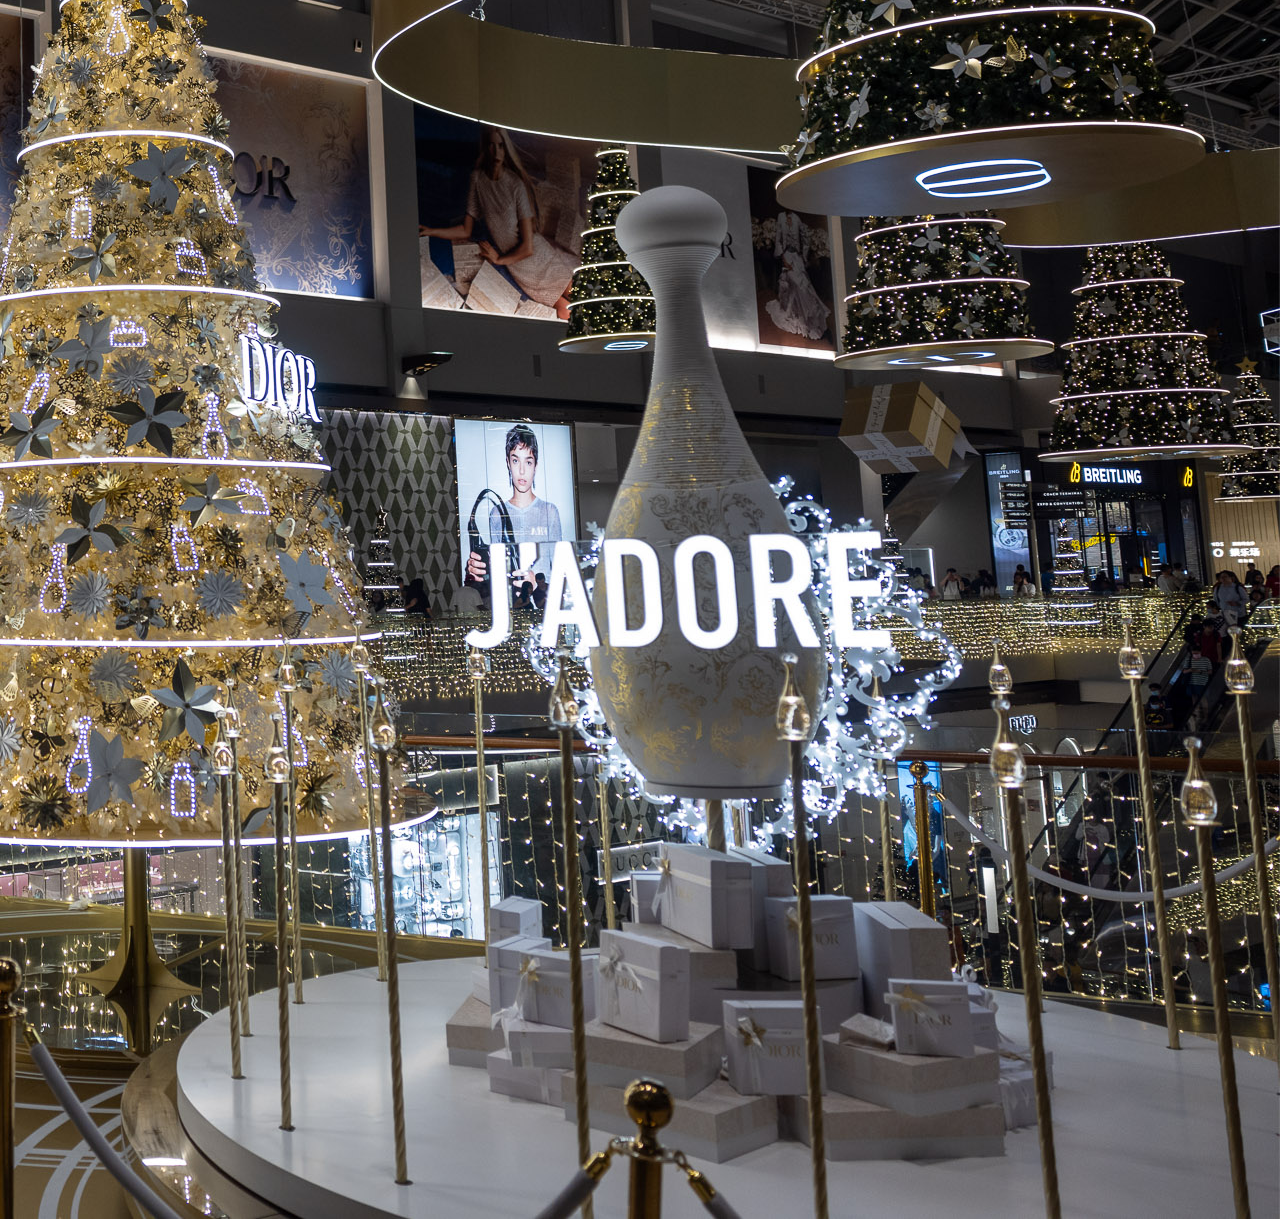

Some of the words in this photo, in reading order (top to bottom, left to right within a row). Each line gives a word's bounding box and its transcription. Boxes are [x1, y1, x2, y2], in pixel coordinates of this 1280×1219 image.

[239, 334, 322, 423] DIOR
[1083, 467, 1142, 484] BREITLING
[465, 531, 891, 649] J'ADORE
